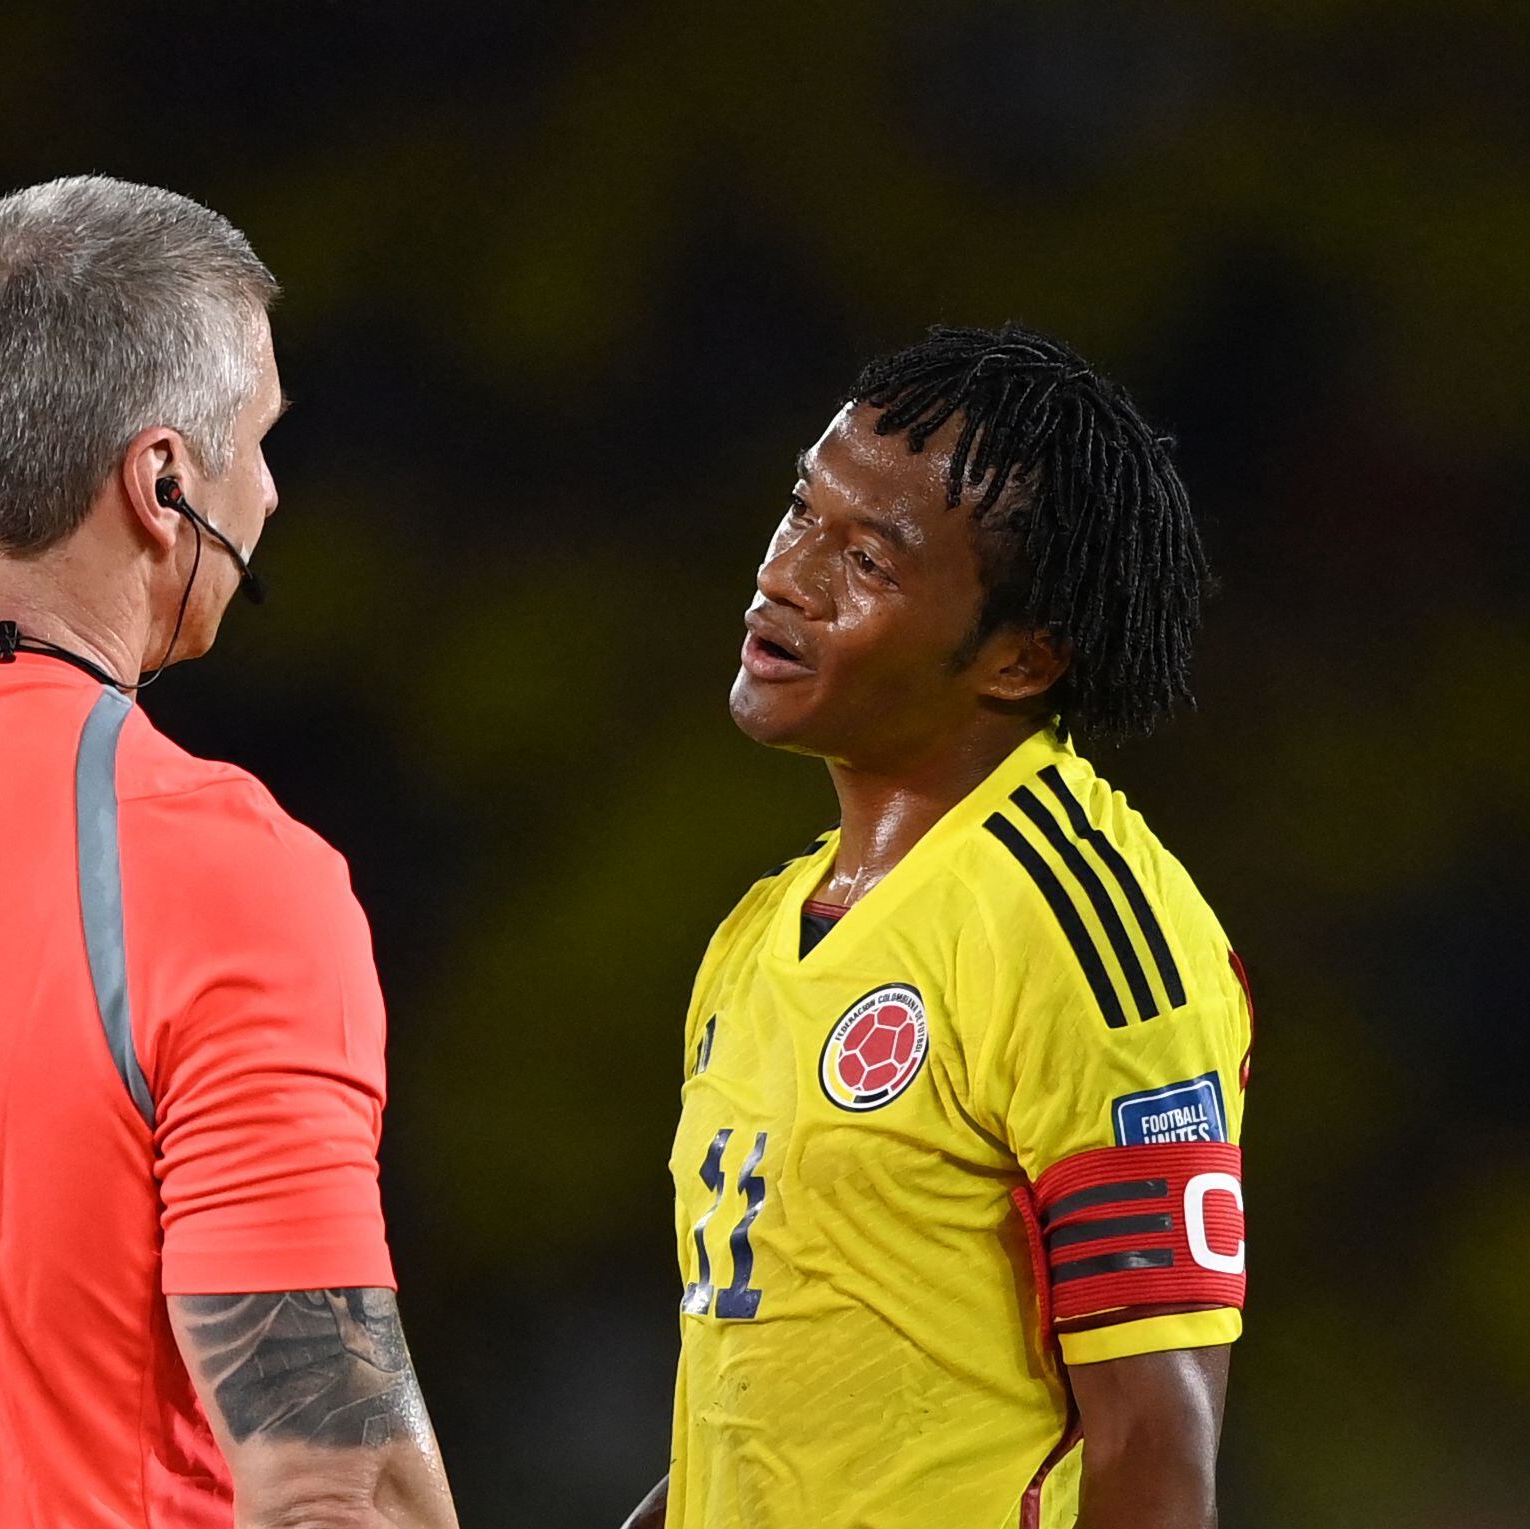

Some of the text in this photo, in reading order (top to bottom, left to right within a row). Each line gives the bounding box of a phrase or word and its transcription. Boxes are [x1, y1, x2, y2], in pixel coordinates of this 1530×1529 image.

[1141, 1103, 1208, 1135] FOOTBALL
[681, 1128, 768, 1319] 11
[1183, 1172, 1245, 1274] C
